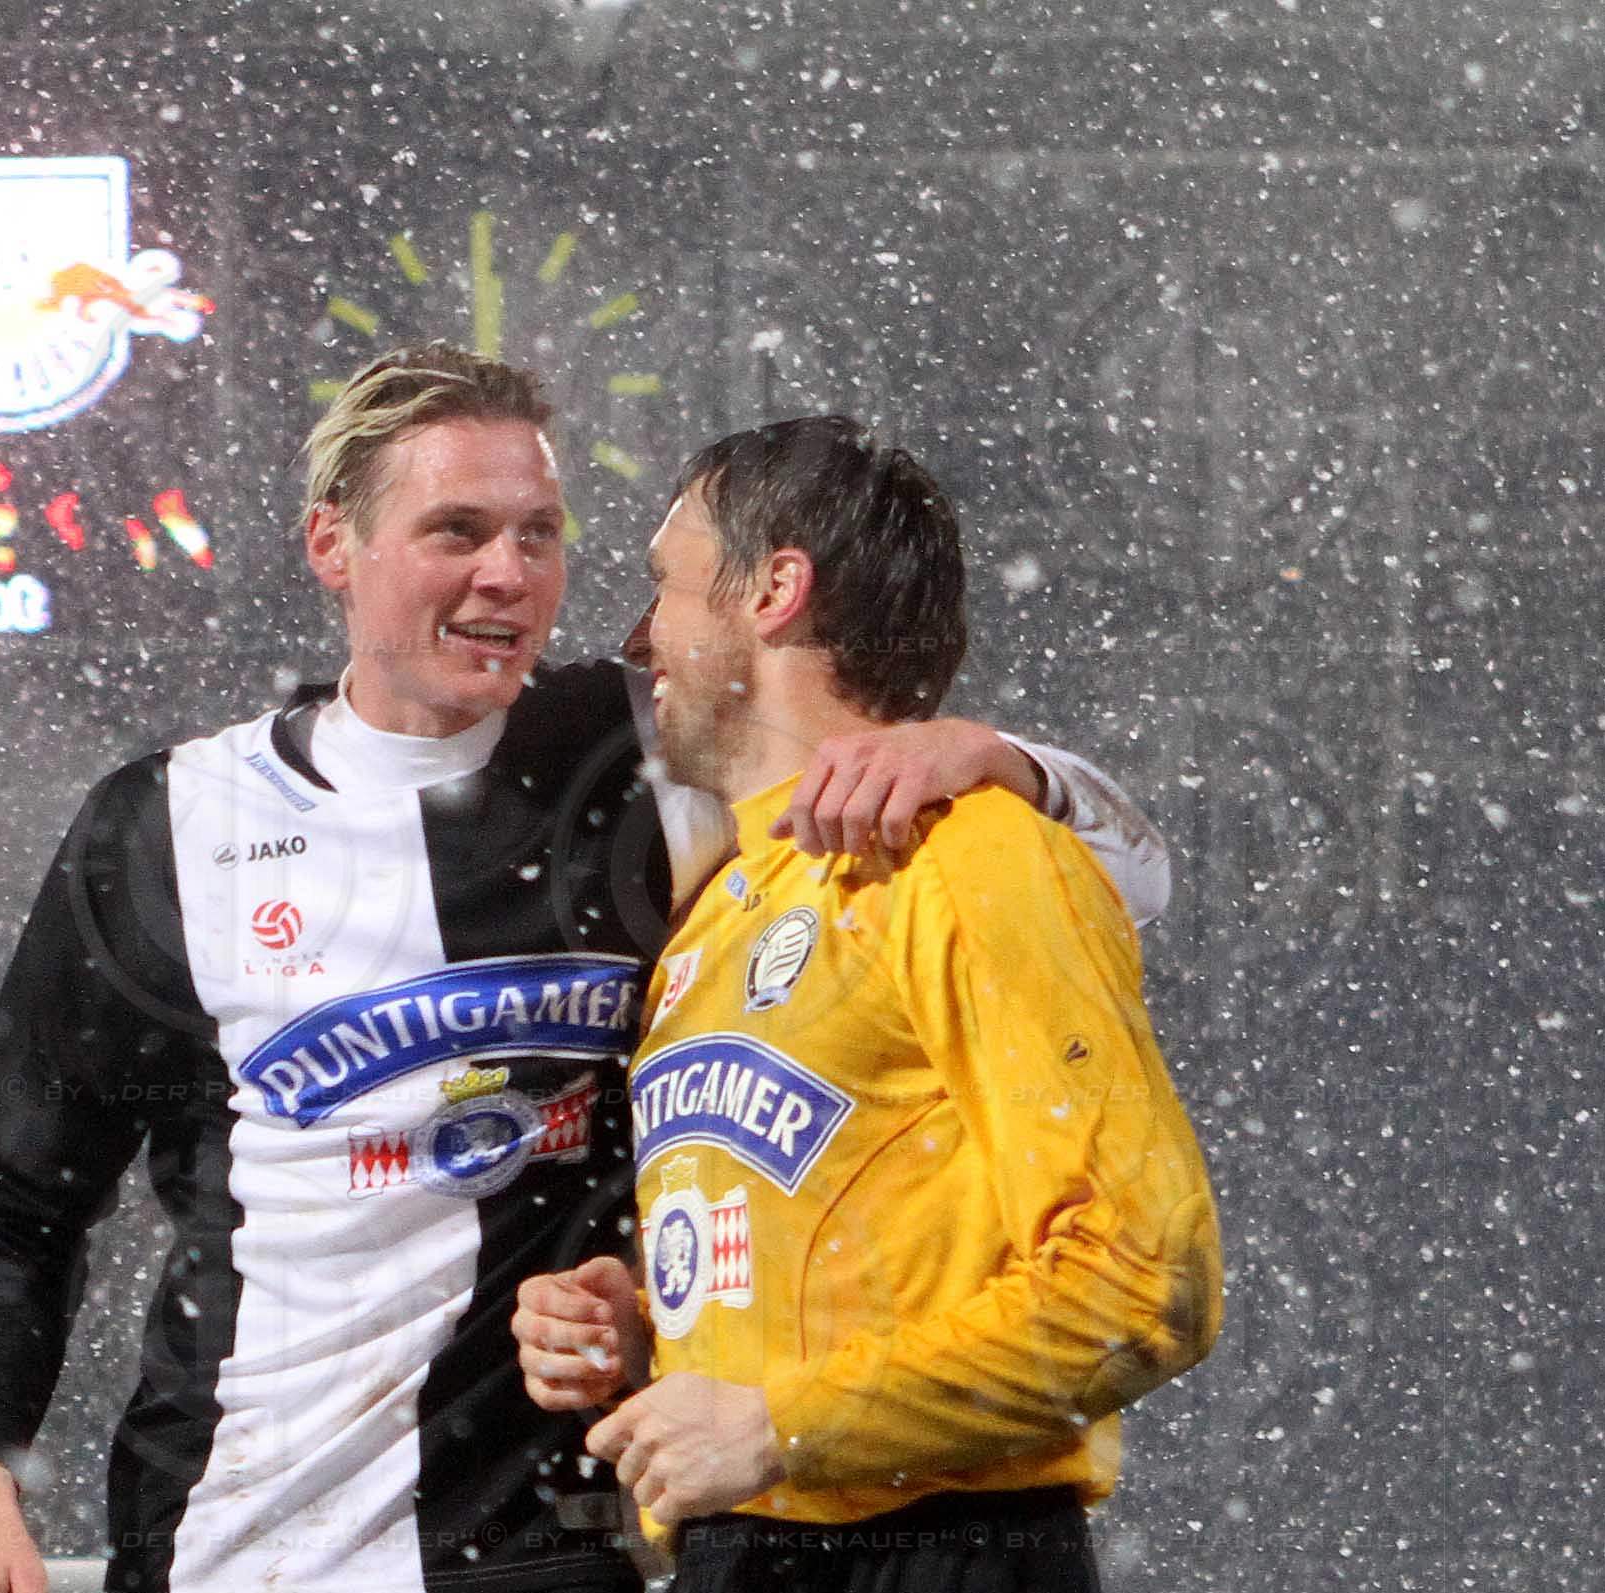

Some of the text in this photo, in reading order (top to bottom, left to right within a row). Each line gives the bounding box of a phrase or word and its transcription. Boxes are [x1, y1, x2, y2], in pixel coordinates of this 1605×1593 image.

[247, 835, 308, 862] JAKO
[245, 961, 325, 977] LIGA
[260, 979, 637, 1112] PUNTIGAMER
